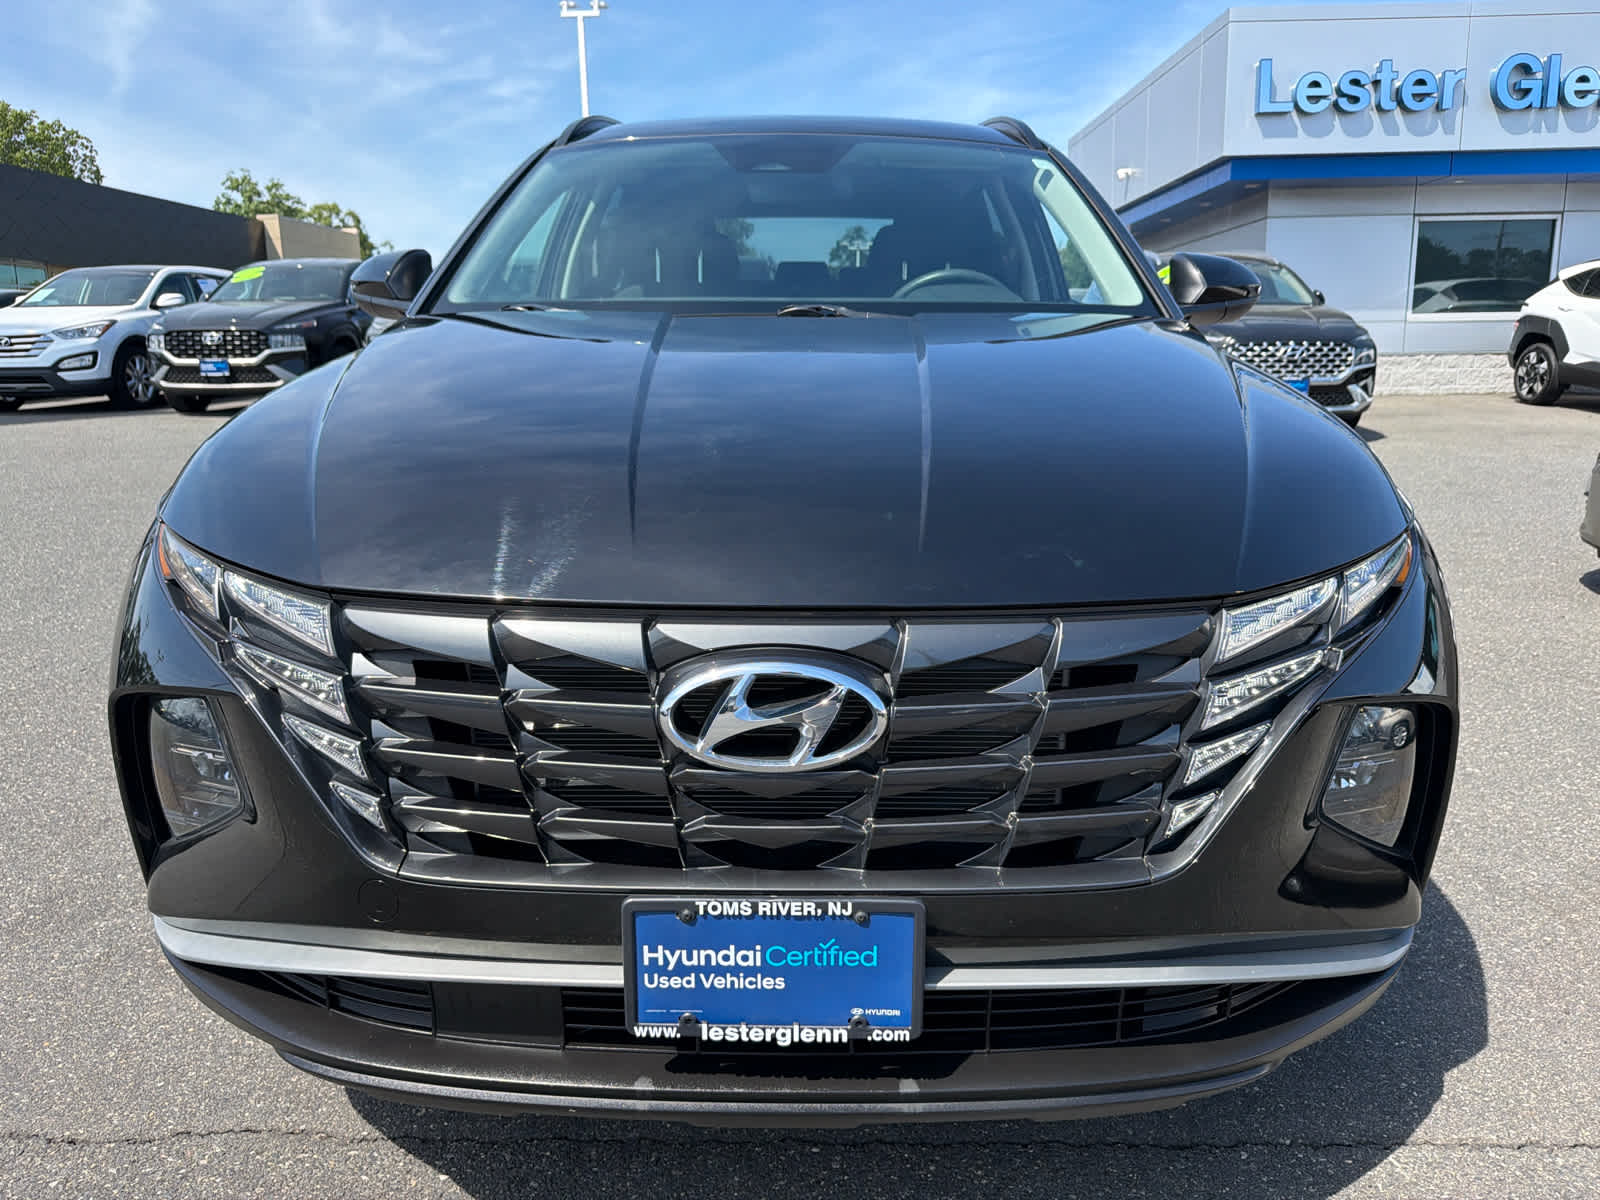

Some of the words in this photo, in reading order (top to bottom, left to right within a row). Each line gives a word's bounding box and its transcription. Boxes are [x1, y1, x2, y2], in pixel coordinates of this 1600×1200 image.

[1255, 58, 1467, 114] Lester
[695, 901, 752, 916] TOMS
[758, 901, 822, 917] RIVER,
[828, 902, 852, 917] NJ
[643, 944, 761, 970] Hyundai
[765, 939, 878, 967] Certified
[643, 973, 695, 989] Used
[699, 973, 786, 990] Vehicles
[865, 1008, 901, 1016] HYUNDAI
[634, 1025, 681, 1039] www.
[701, 1024, 848, 1046] lesterglenn
[867, 1029, 910, 1042] .com
